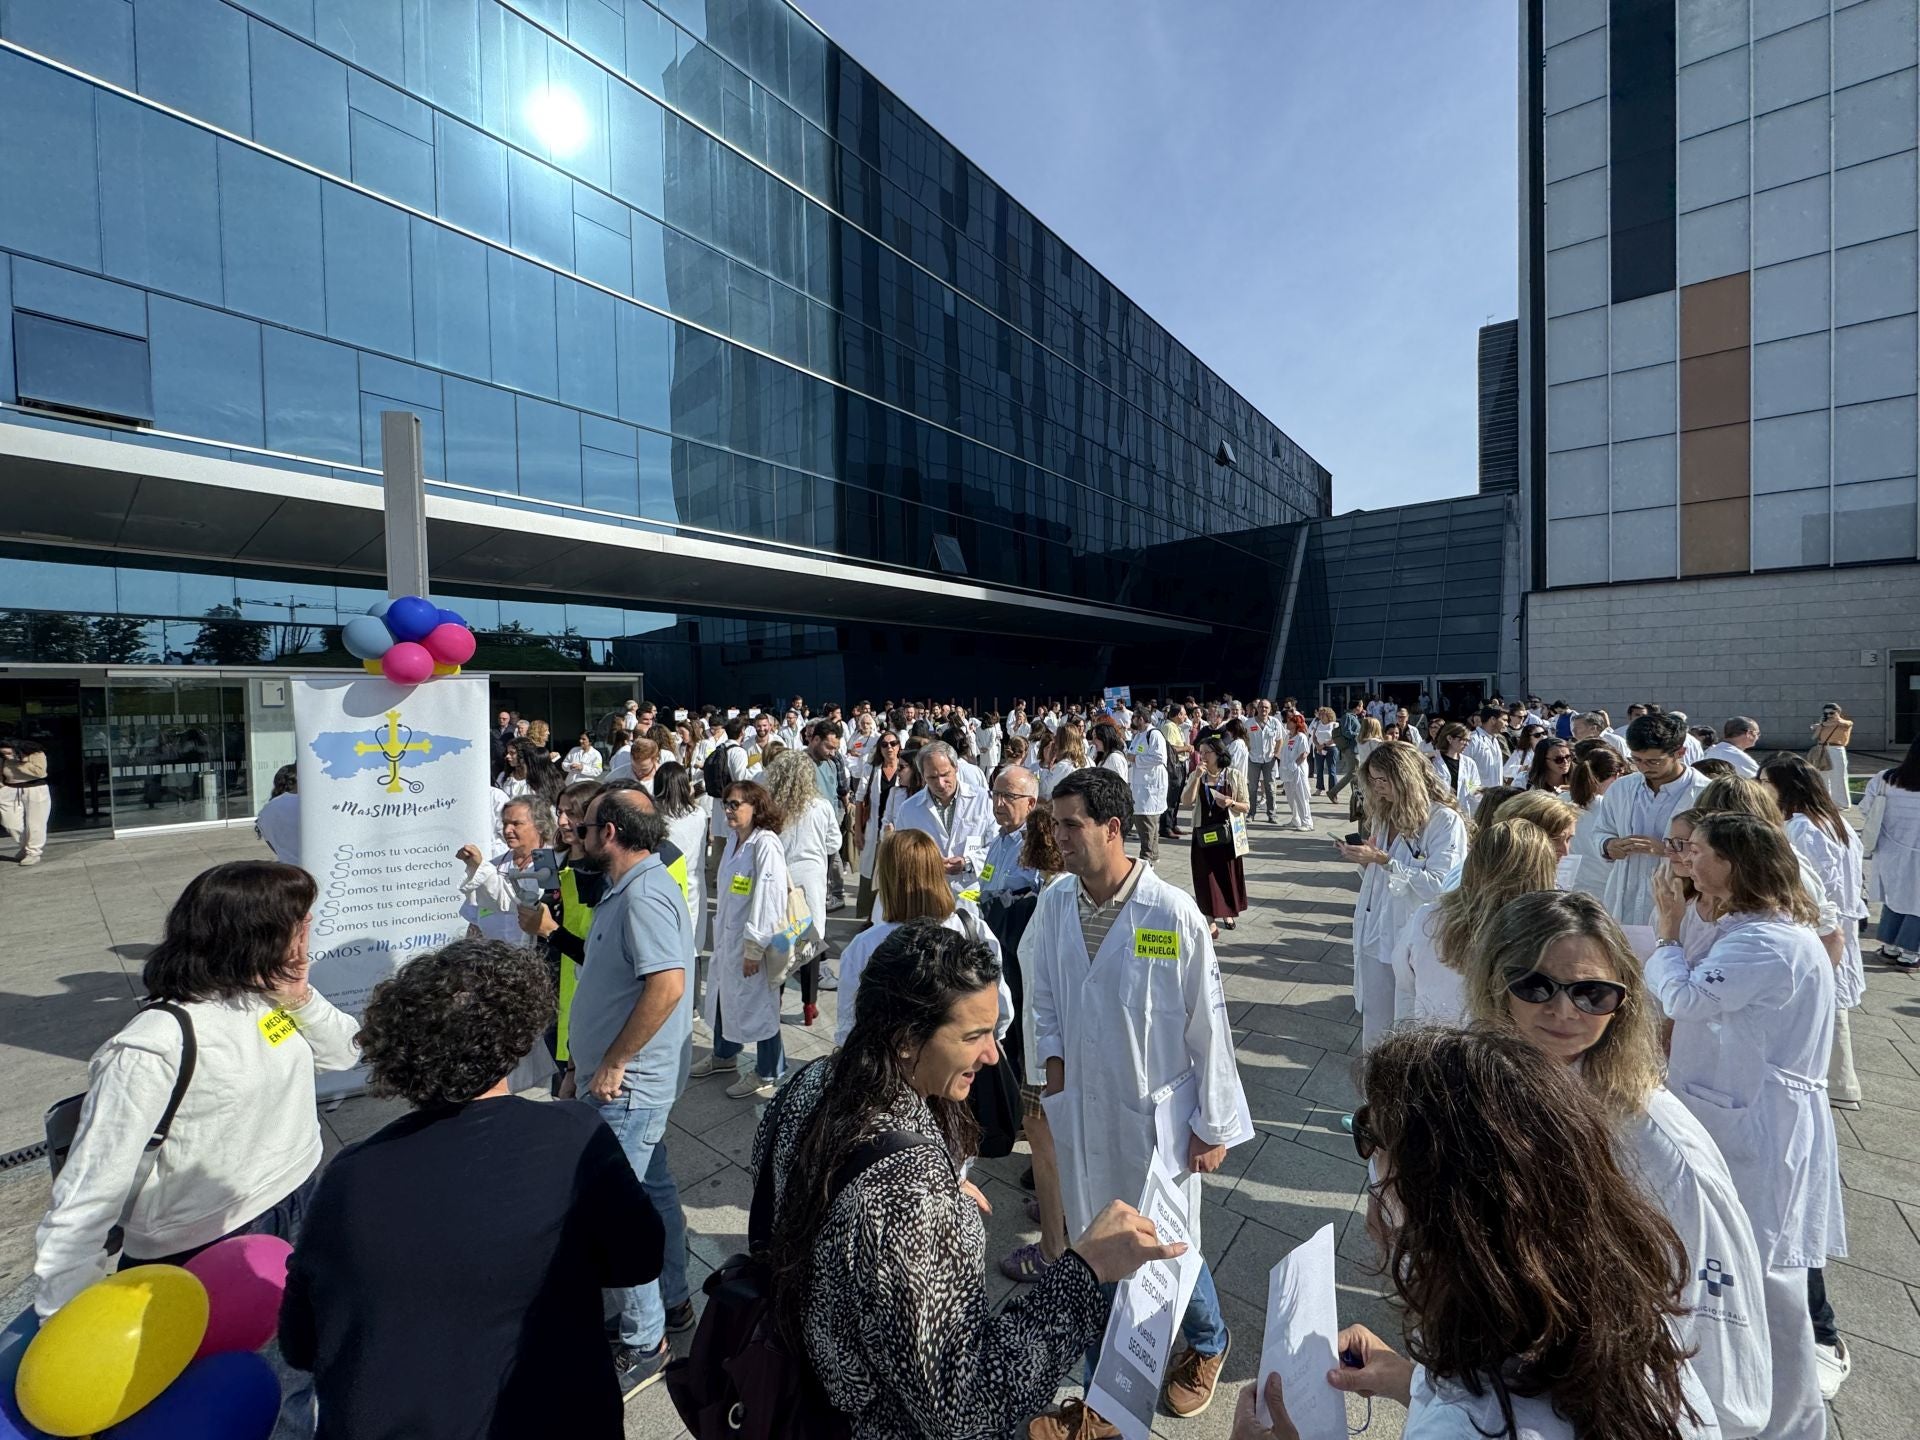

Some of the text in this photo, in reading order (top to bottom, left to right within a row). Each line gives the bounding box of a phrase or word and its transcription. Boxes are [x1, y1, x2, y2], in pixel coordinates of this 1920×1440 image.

[1870, 653, 1878, 663] 3
[276, 687, 284, 701] 1
[333, 843, 450, 861] Somos tu vocación
[330, 860, 453, 879] Somos tus derechos
[326, 877, 451, 898] Somos tu integridad
[320, 893, 461, 918] Somos tus compañeros
[314, 912, 461, 936] Somos tus incondiciona
[306, 945, 361, 962] SOMOS
[1138, 945, 1176, 956] EN HUELGA
[264, 1010, 289, 1031] MEDIC
[269, 1019, 297, 1043] EN HUE
[1141, 1274, 1169, 1312] DESCANSO
[1128, 1336, 1157, 1373] SEGURIDAD
